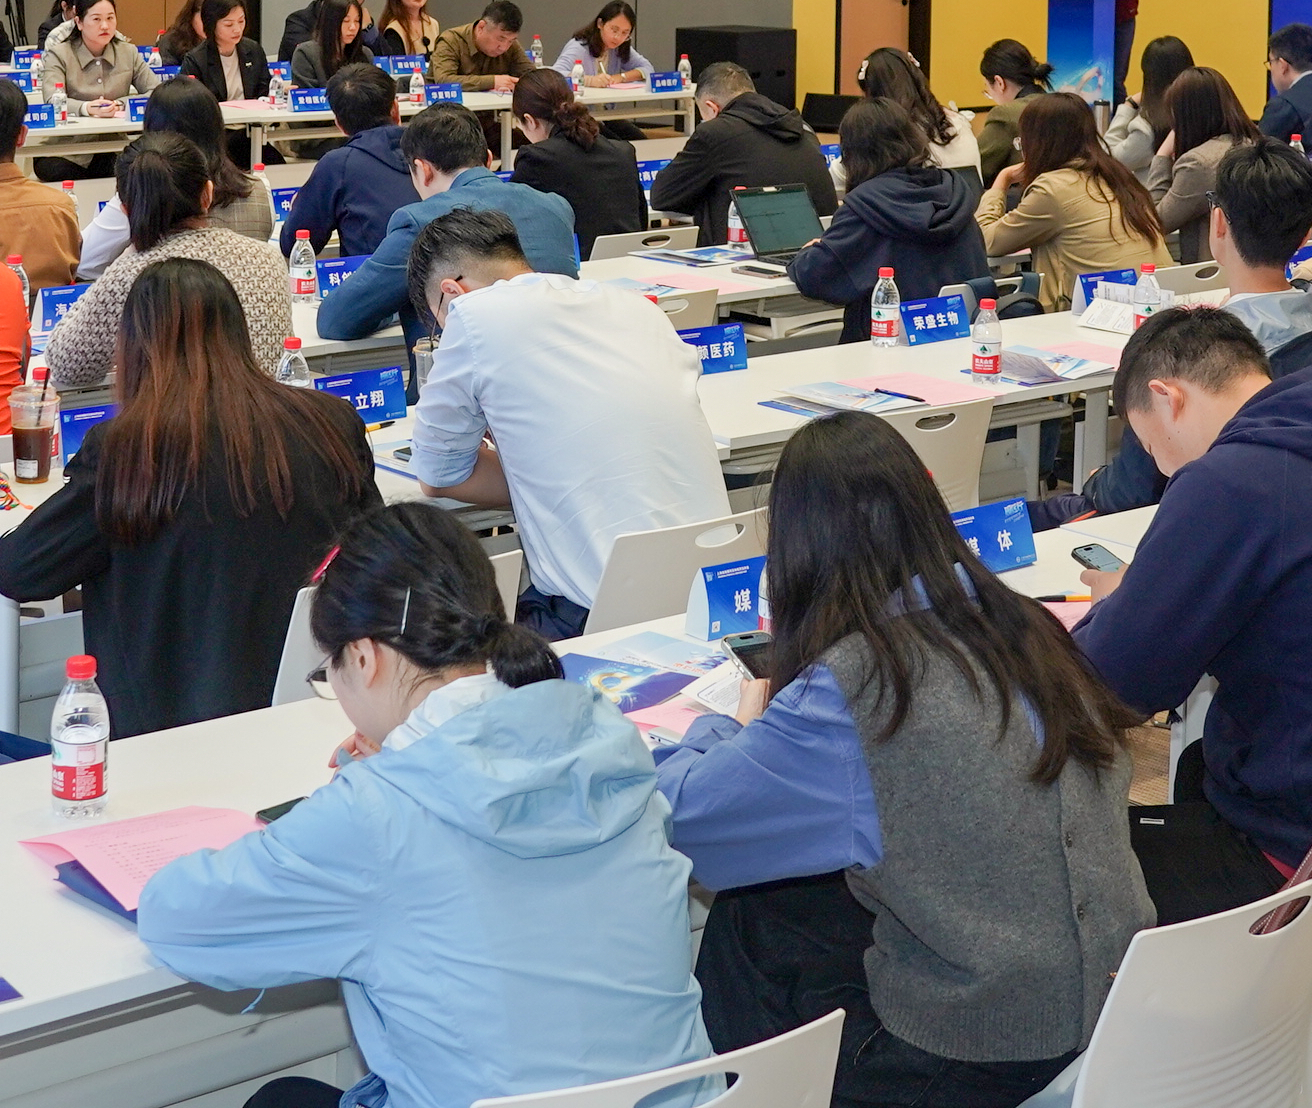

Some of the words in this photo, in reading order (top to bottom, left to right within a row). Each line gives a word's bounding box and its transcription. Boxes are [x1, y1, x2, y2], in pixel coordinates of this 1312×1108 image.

[913, 311, 959, 330] 荣盛生物
[997, 529, 1013, 552] 体
[734, 588, 752, 613] 媒
